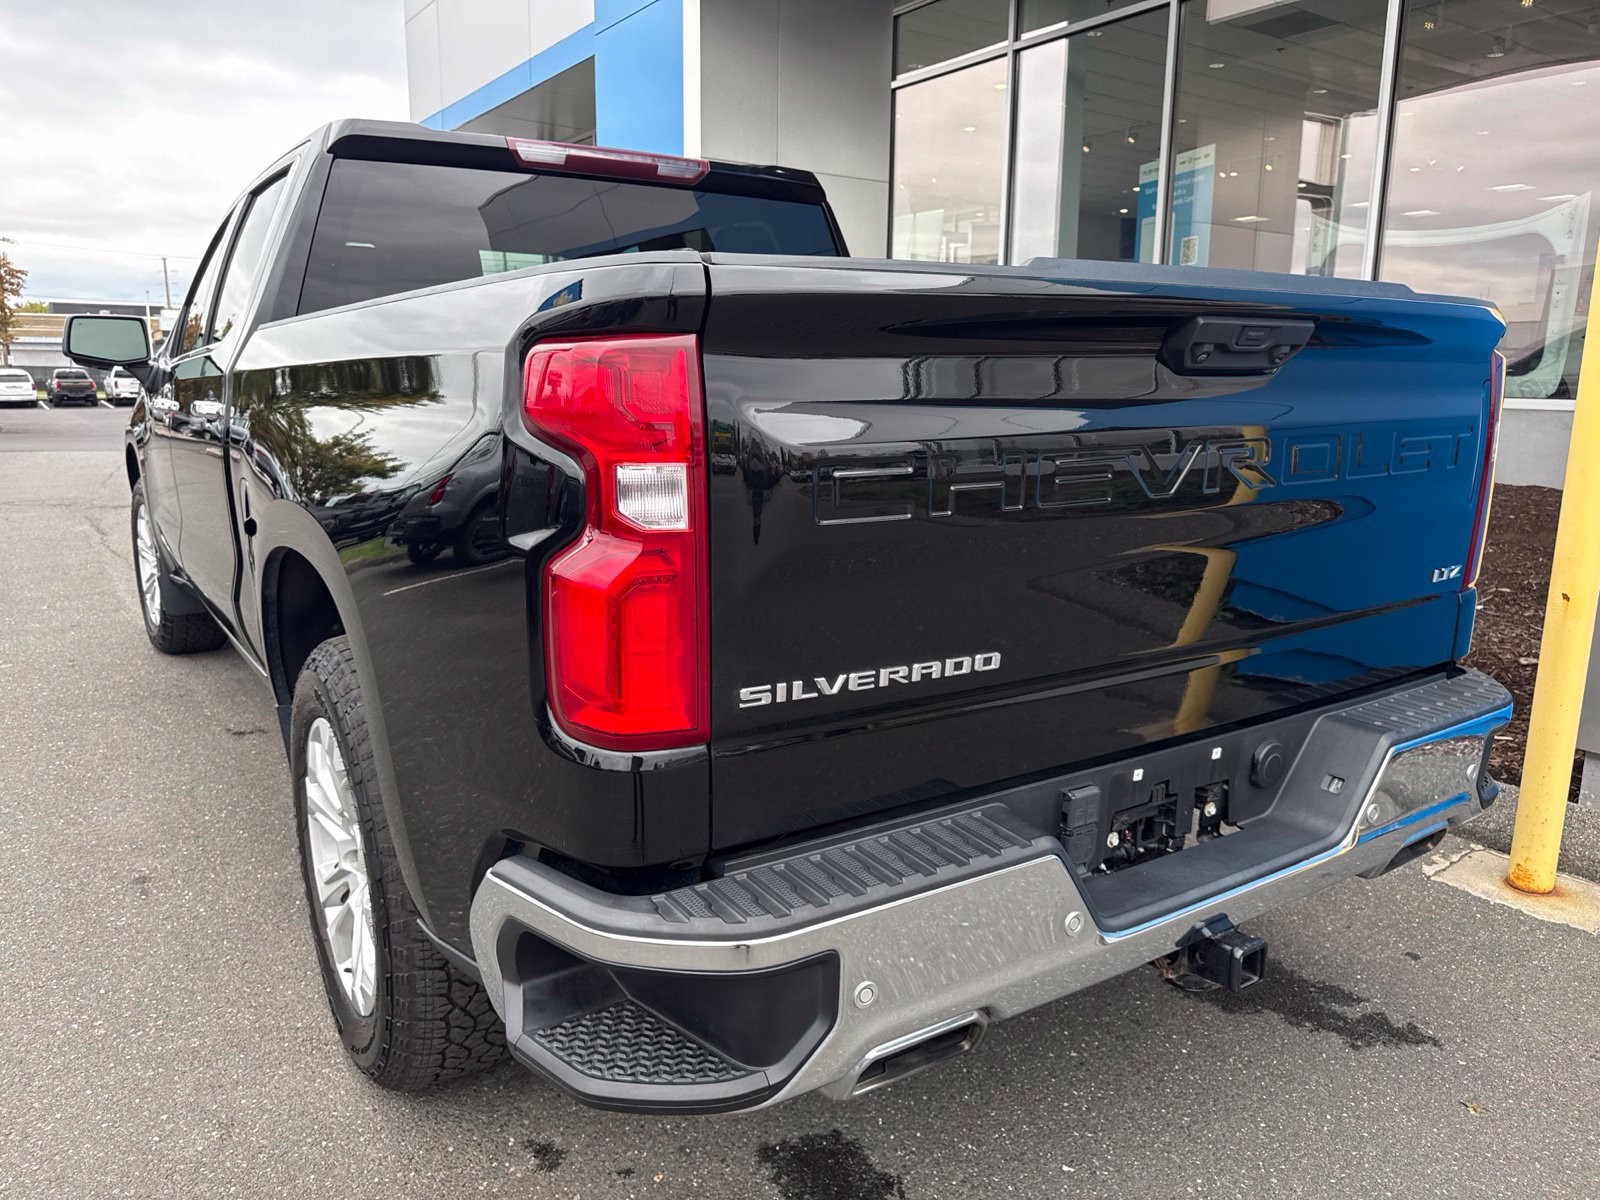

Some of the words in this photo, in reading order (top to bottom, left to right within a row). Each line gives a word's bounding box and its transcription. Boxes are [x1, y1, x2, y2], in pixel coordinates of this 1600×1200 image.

[812, 425, 1474, 526] CHEVROLET
[1432, 564, 1463, 583] LTZ
[738, 651, 1002, 708] SILVERADO
